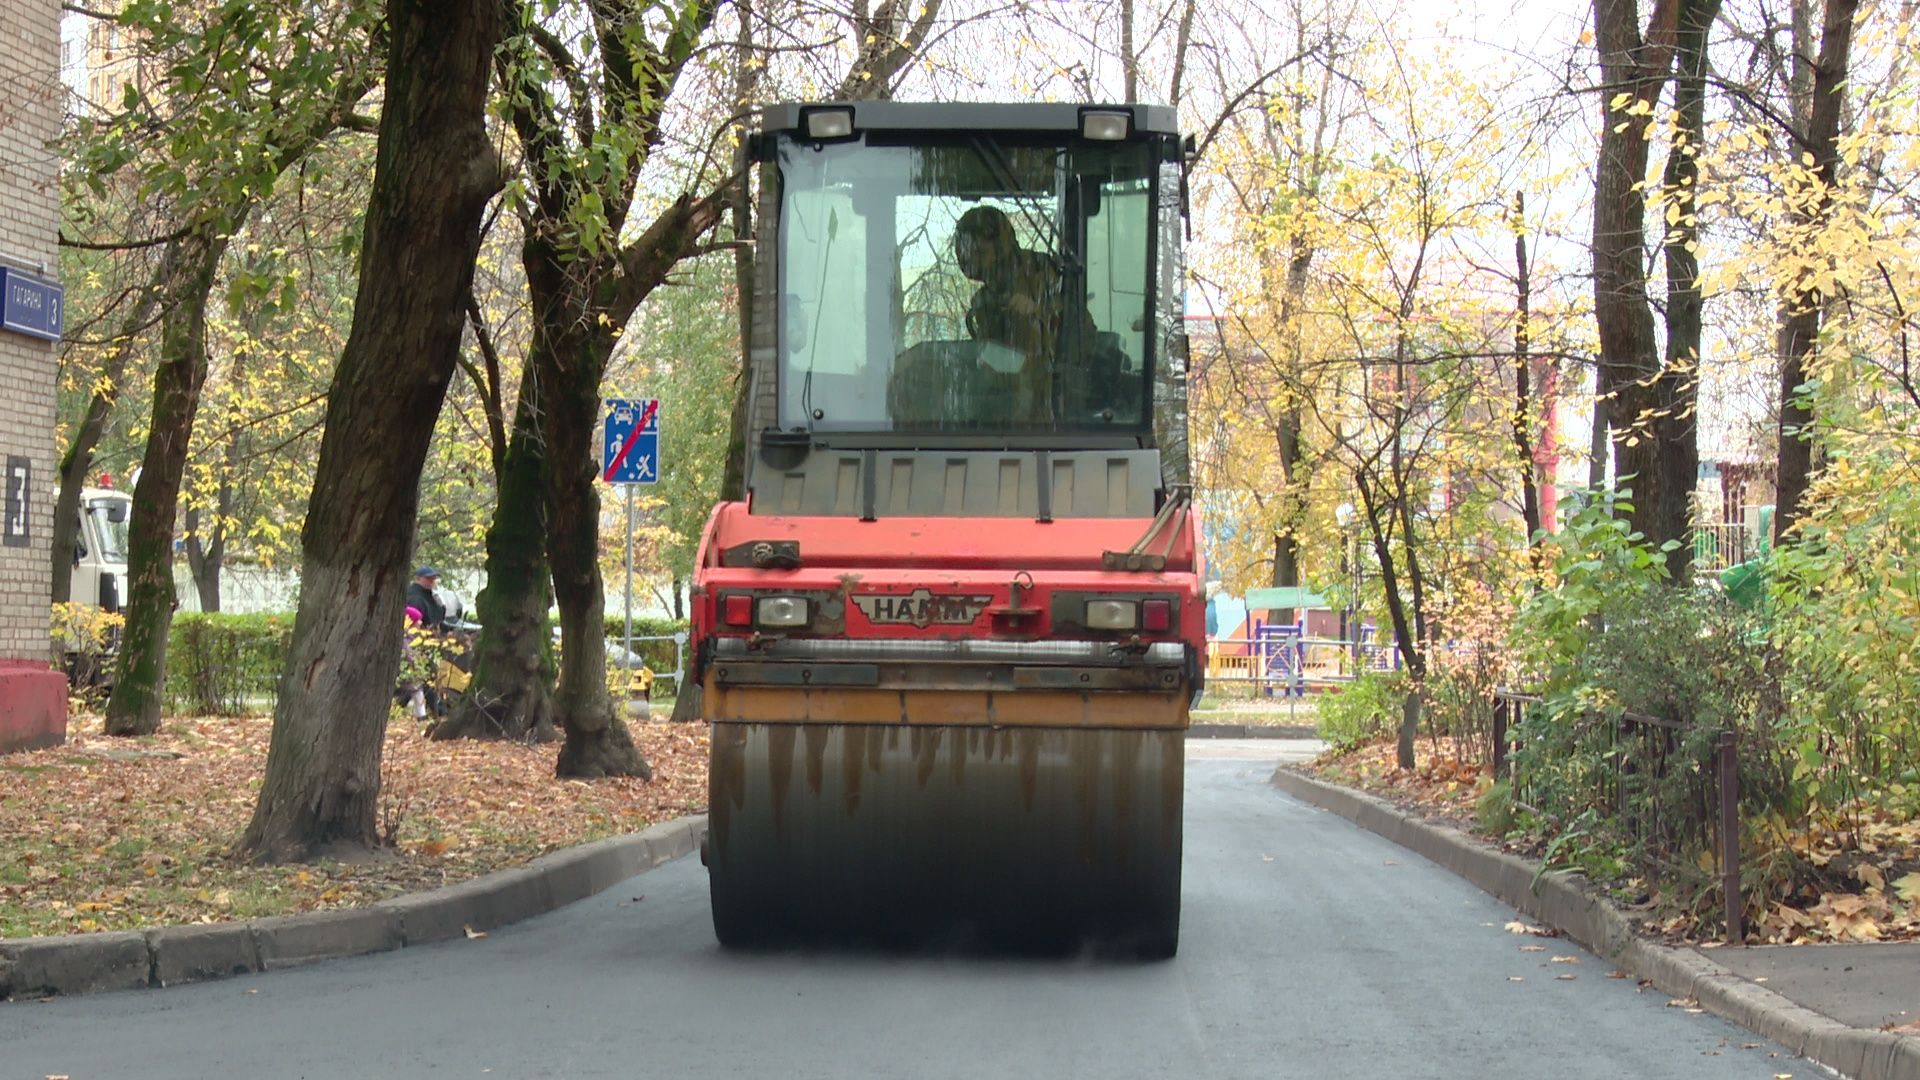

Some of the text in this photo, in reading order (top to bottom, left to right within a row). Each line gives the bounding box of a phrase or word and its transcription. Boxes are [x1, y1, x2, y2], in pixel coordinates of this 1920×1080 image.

[13, 285, 42, 311] ГАГАРИНА
[51, 299, 58, 326] 3
[12, 467, 26, 535] 3
